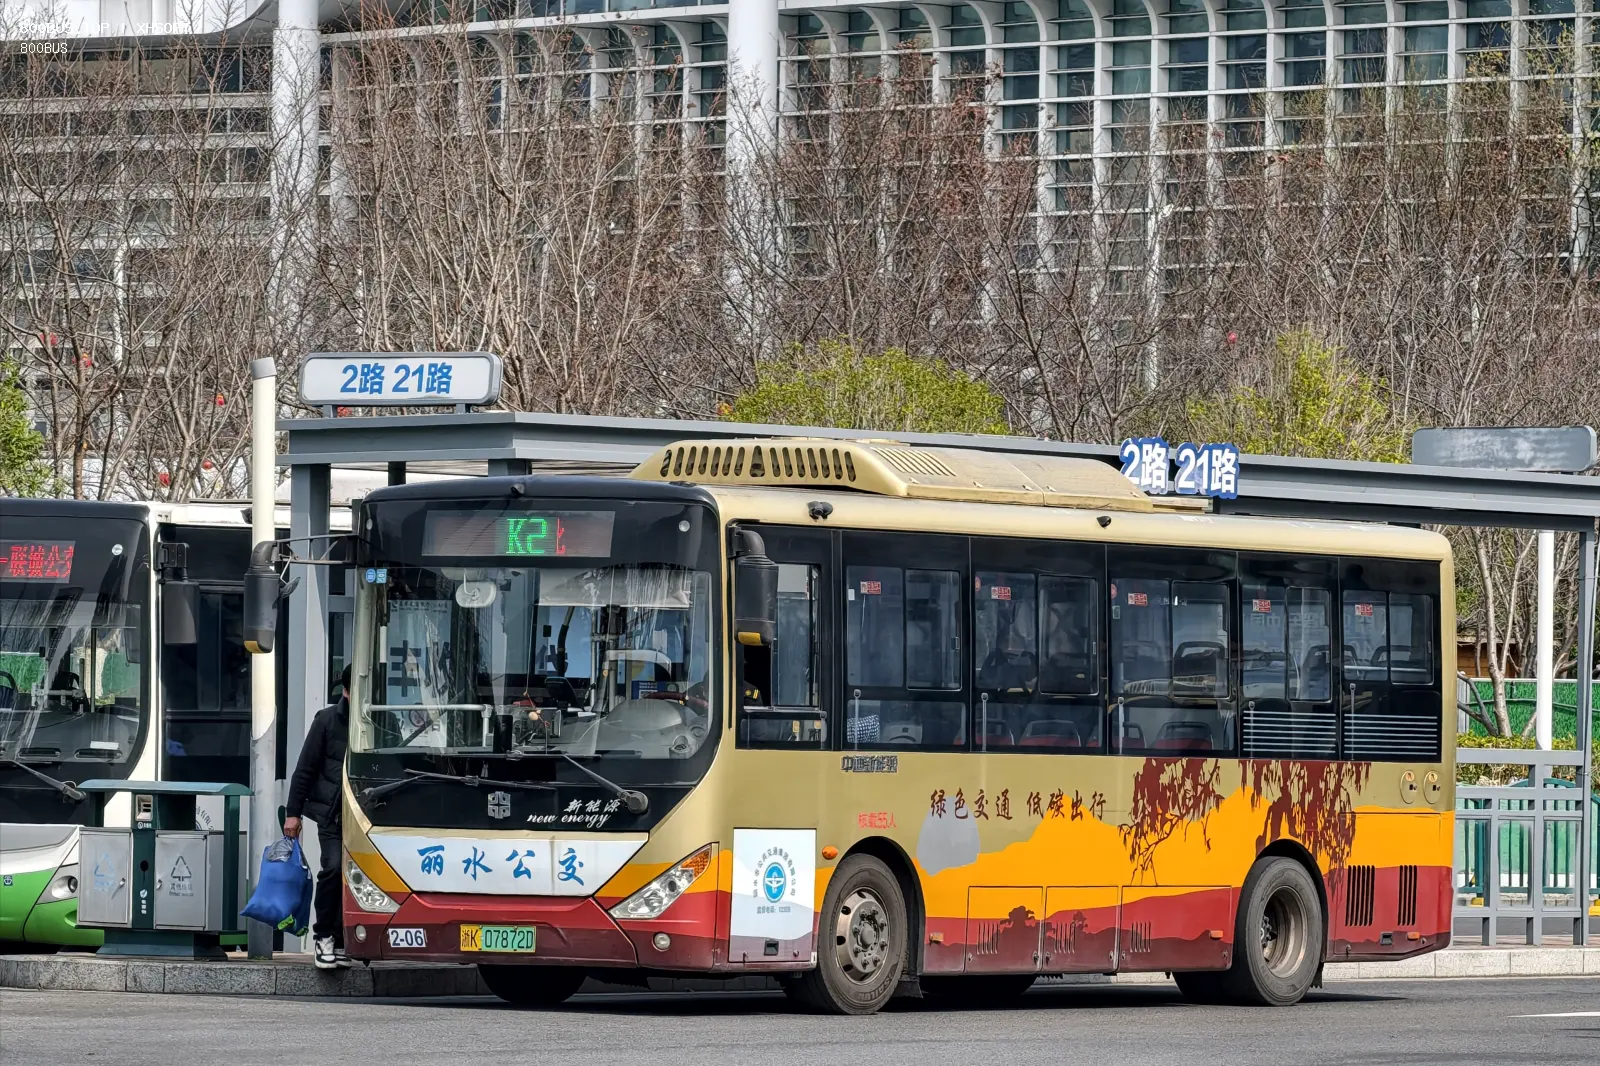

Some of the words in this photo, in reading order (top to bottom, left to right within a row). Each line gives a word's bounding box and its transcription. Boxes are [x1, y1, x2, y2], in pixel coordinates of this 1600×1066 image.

[340, 362, 386, 395] 2路
[391, 362, 453, 395] 21路
[1121, 443, 1168, 489] 2路
[1178, 448, 1237, 494] 21路
[506, 518, 548, 554] K2
[563, 799, 621, 814] 新能源
[930, 787, 1014, 821] 绿色交通
[1026, 788, 1107, 821] 低碳出行
[526, 813, 558, 824] new
[561, 813, 611, 829] energy
[416, 845, 585, 887] 丽水公交
[390, 929, 424, 946] 2-06
